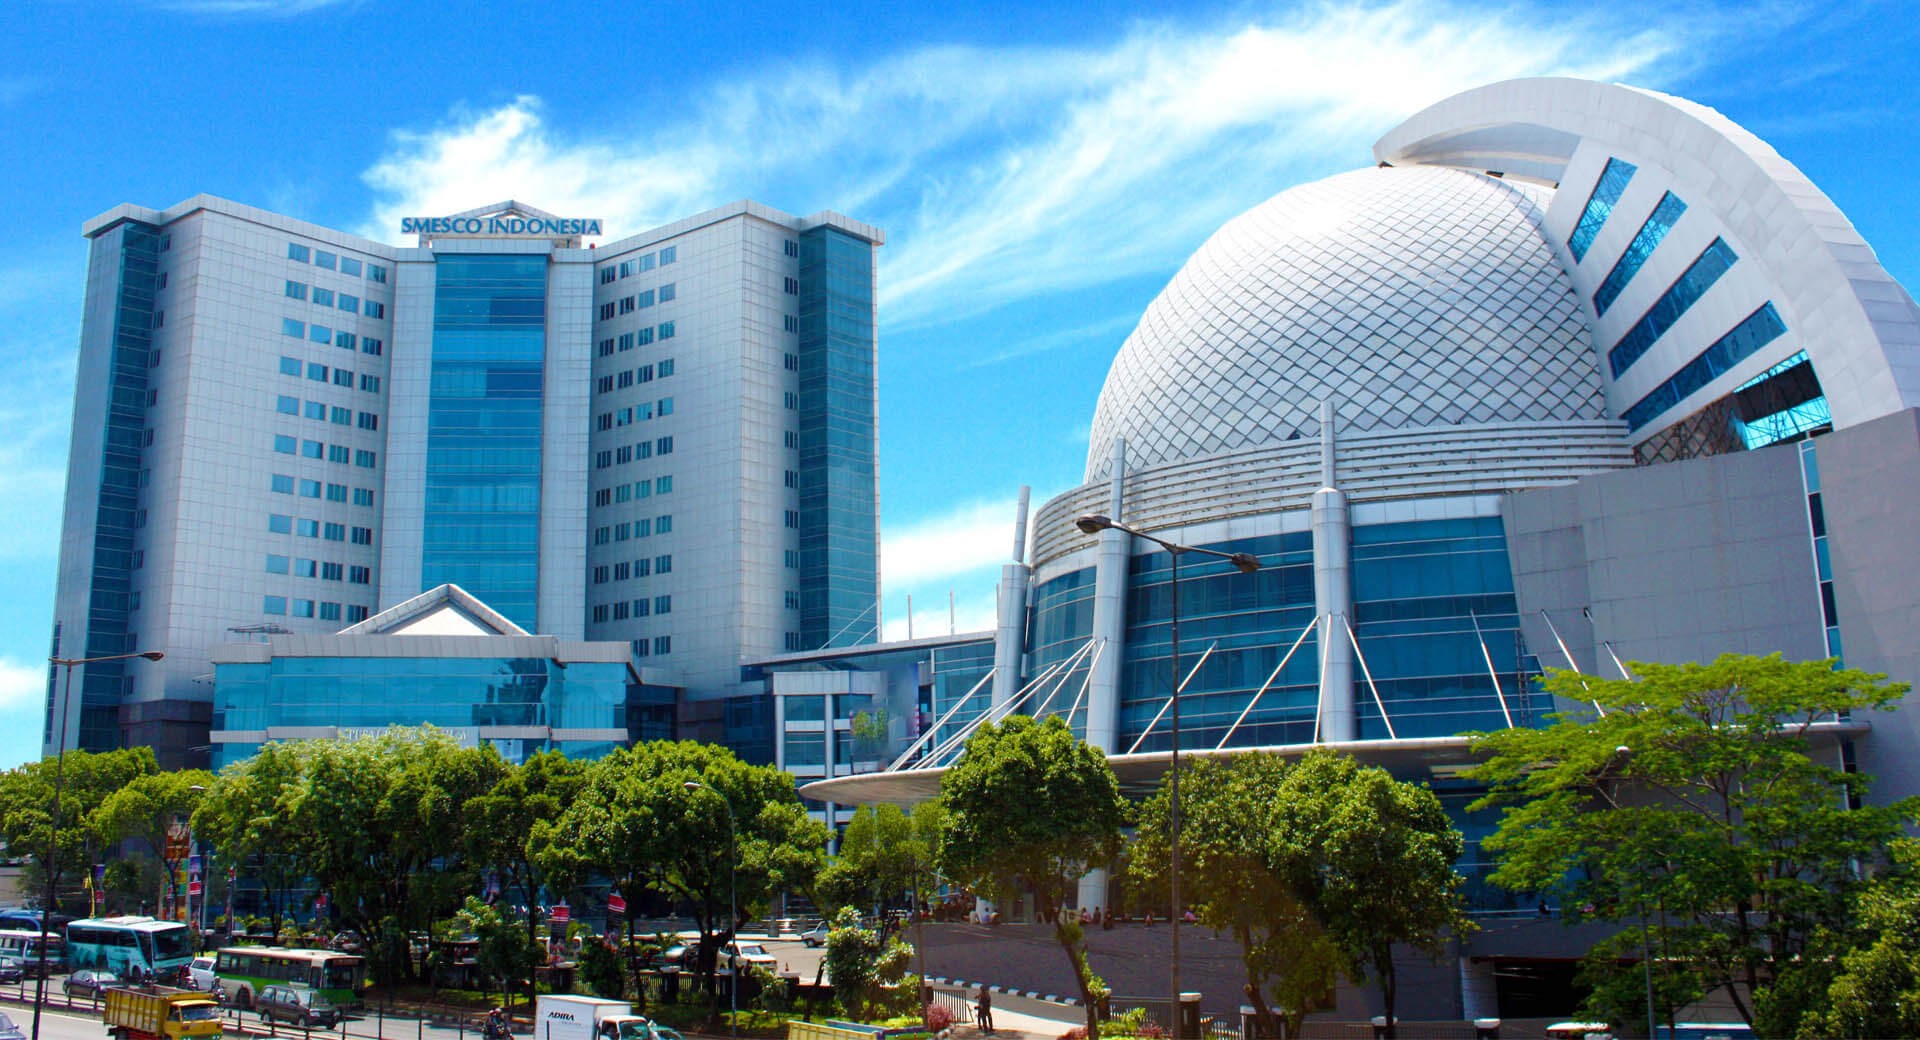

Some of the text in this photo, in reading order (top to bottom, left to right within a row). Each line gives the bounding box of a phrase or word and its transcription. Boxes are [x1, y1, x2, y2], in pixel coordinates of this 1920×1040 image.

[401, 217, 601, 236] SMESCO INDONESIA
[547, 1011, 575, 1021] ADIRA
